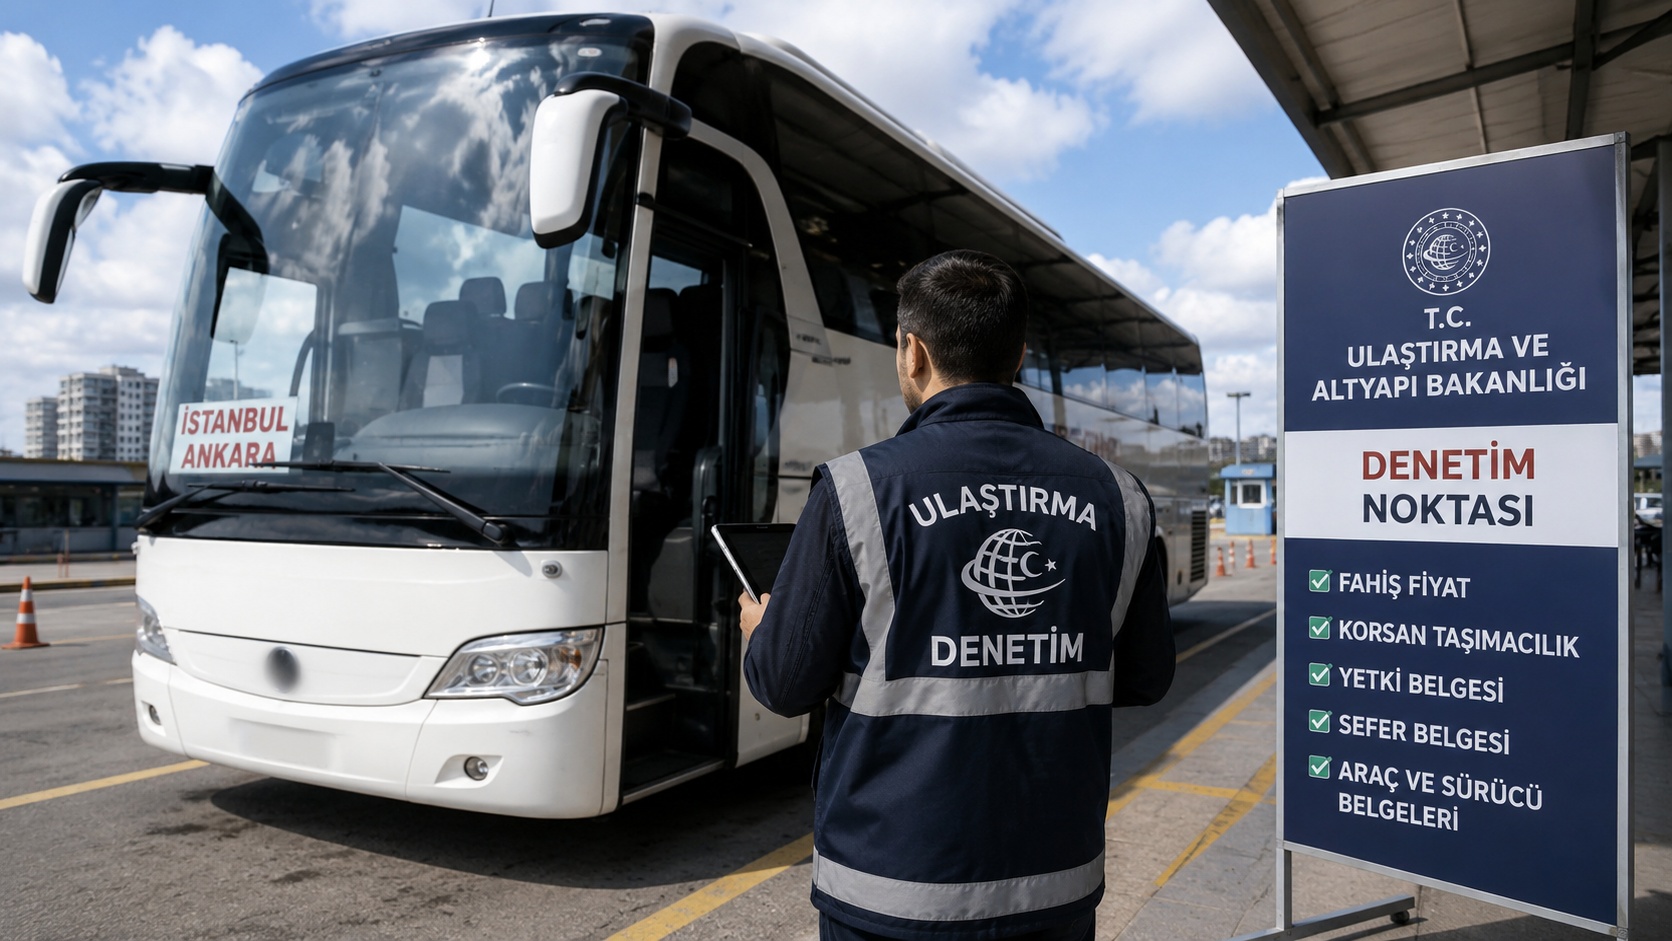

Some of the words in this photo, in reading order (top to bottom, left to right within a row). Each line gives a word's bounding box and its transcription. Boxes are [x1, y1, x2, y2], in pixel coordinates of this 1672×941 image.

[1424, 306, 1471, 329] T.C.
[1347, 336, 1504, 369] ULAŞTIRMA
[1512, 334, 1548, 357] VE
[1312, 376, 1417, 401] ALTYAPI
[1427, 361, 1586, 396] BAKANLIĞI
[181, 405, 288, 435] İSTANBUL
[181, 441, 276, 469] ANKARA
[1364, 441, 1534, 479] DENETİM
[908, 483, 1096, 532] ULAŞTIRMA
[1364, 494, 1532, 526] NOKTASI
[1340, 570, 1401, 599] FAHİŞ
[1409, 571, 1470, 598] FİYAT
[932, 626, 1083, 666] DENETİM
[1340, 620, 1426, 645] KORSAN
[1433, 626, 1579, 658] TAŞIMACILIK
[1339, 667, 1400, 692] YETKİ
[1409, 674, 1503, 703] BELGESİ
[1339, 715, 1406, 741] SEFER
[1414, 723, 1509, 754] BELGESİ
[1338, 761, 1399, 792] ARAÇ
[1406, 770, 1434, 793] VE
[1441, 773, 1543, 811] SÜRÜCÜ
[1339, 793, 1458, 831] BELGELERİ
